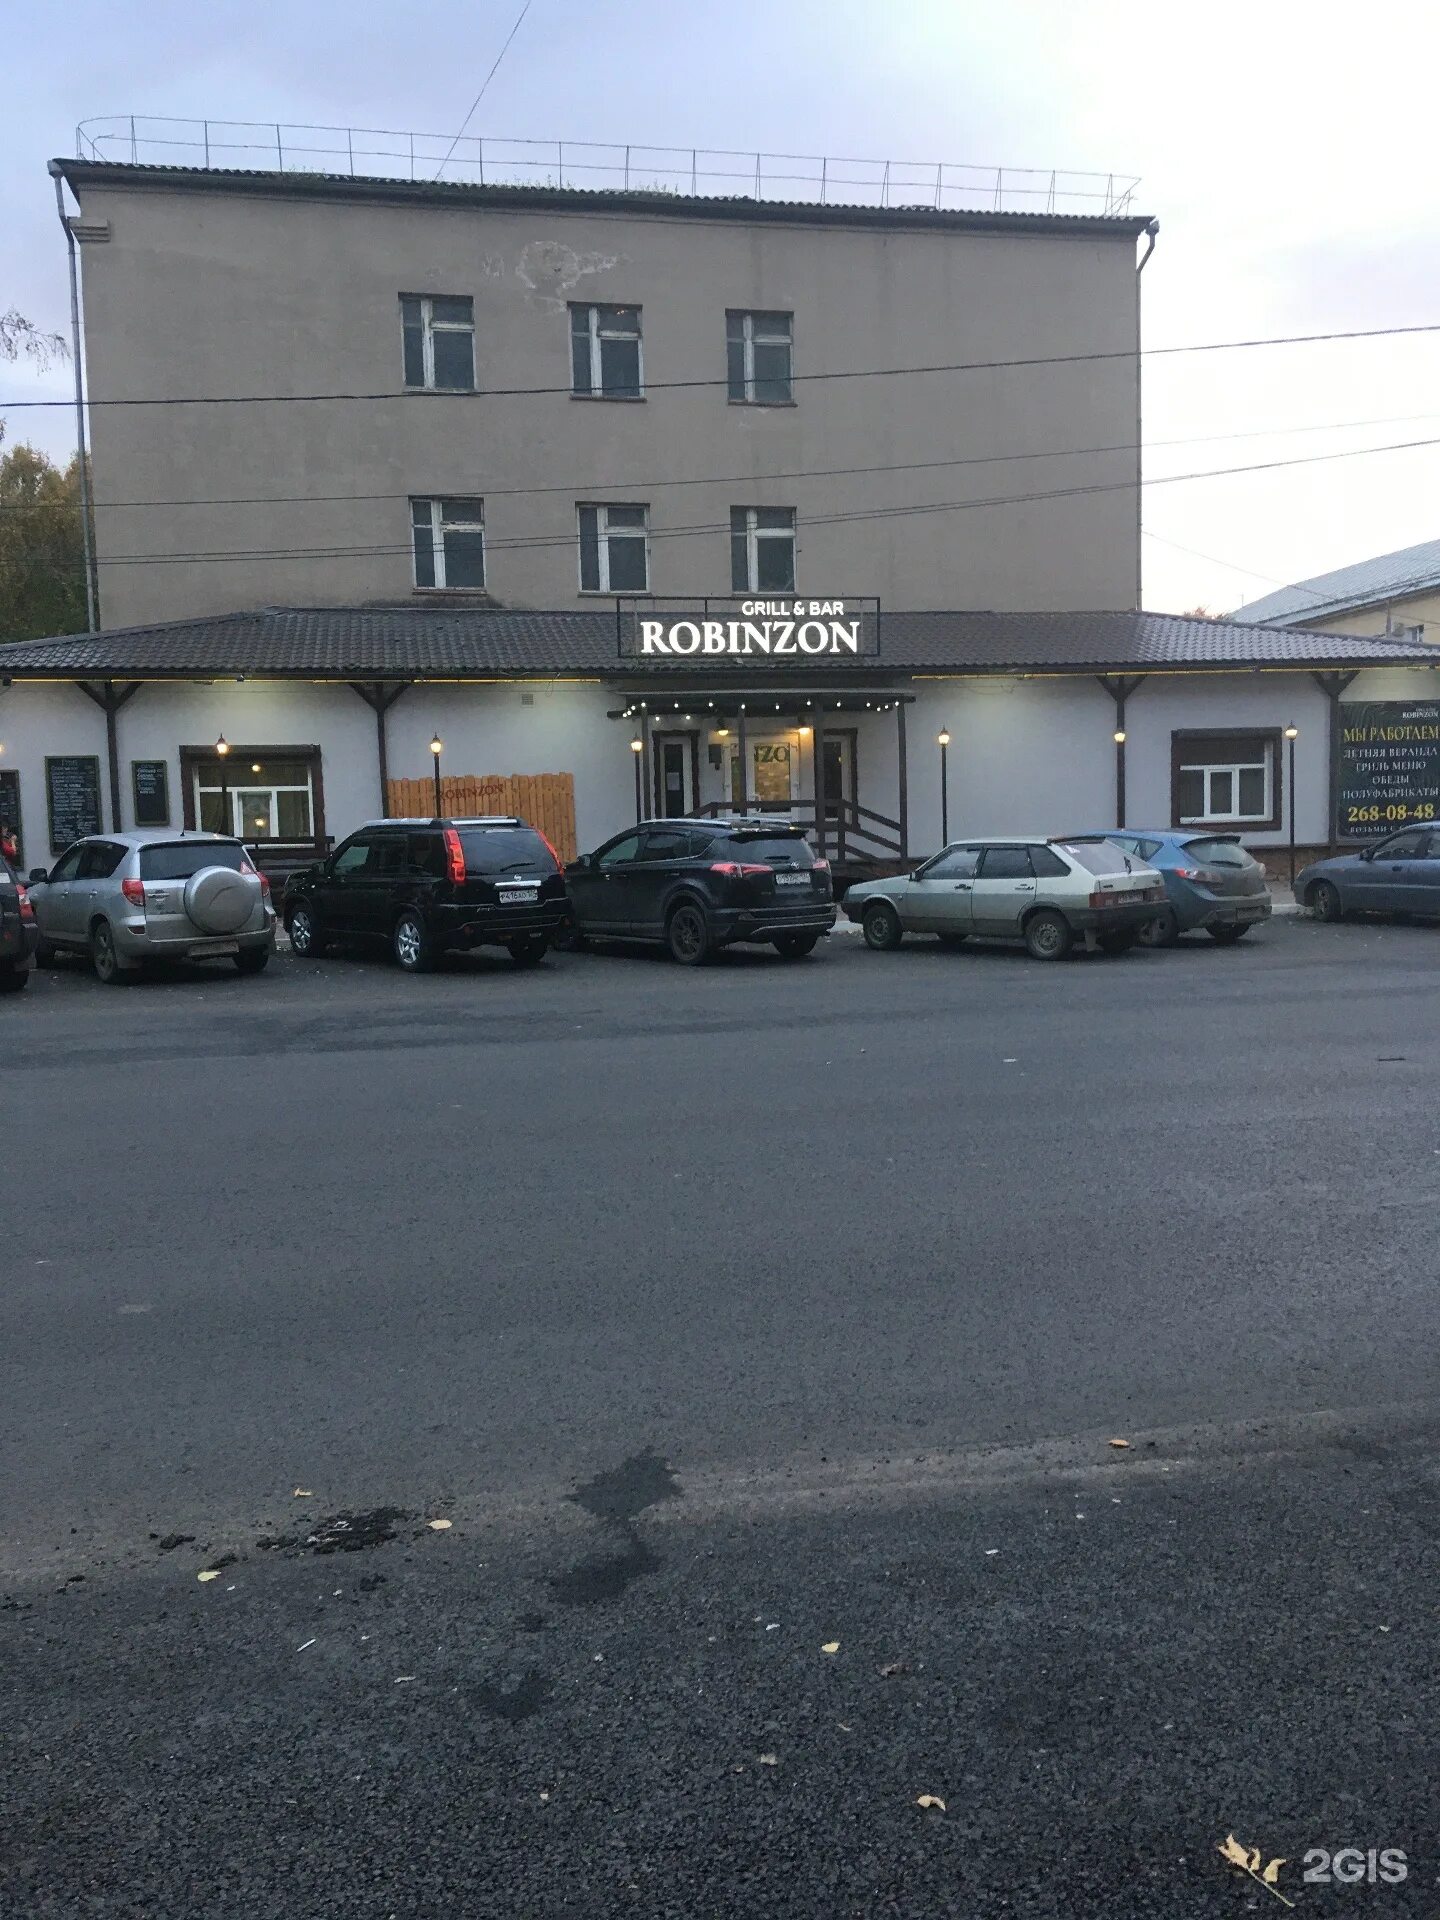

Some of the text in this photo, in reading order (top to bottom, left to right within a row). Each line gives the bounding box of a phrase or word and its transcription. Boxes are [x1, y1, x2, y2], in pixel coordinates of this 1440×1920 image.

[741, 601, 844, 616] GRILL & BAR
[640, 621, 860, 654] ROBINZON
[1344, 725, 1440, 741] МЫ РАБОТАЕМ
[1343, 746, 1438, 758] ЛЕТНЯЯ ВЕРАНДА
[1356, 761, 1427, 772] ГРИЛЬ МЕНЮ
[1372, 775, 1409, 785] ОБЕДЫ
[1343, 787, 1439, 799] ПОЛУФАБРИКАТЫ
[1348, 803, 1435, 822] 268-08-48
